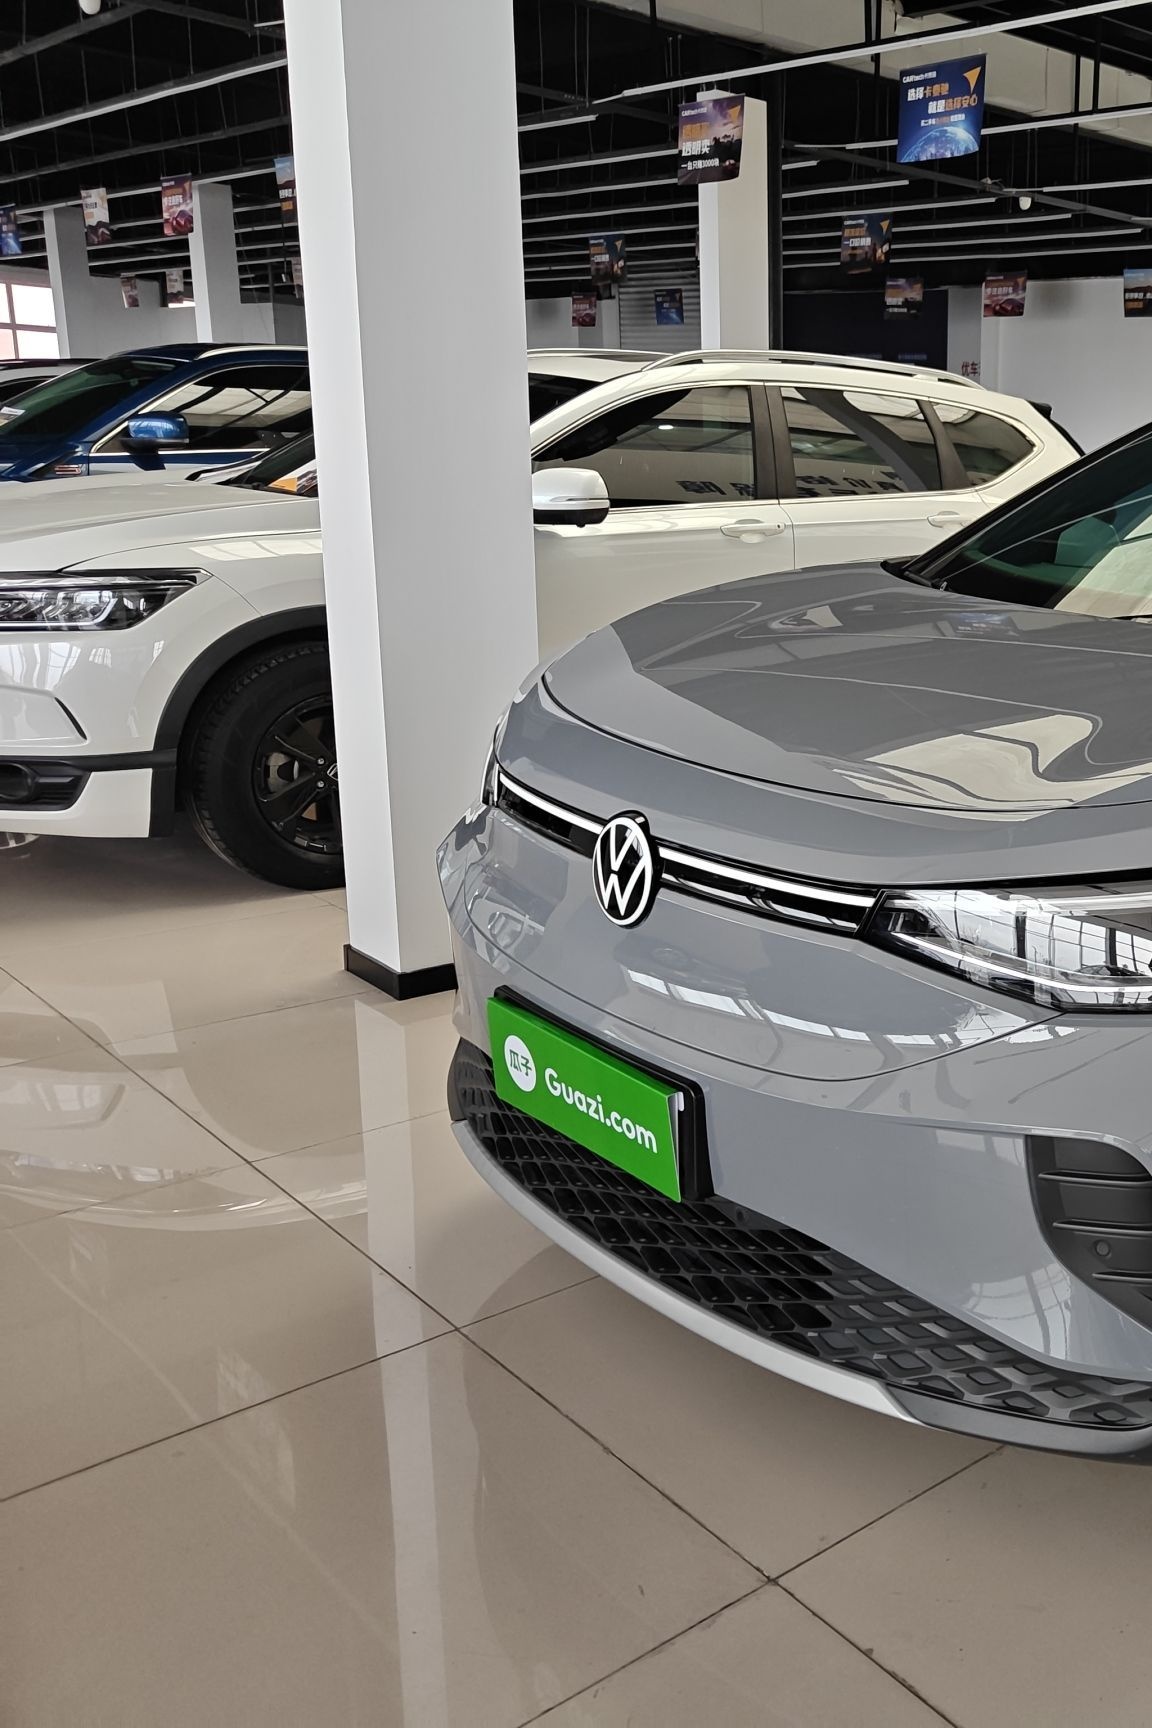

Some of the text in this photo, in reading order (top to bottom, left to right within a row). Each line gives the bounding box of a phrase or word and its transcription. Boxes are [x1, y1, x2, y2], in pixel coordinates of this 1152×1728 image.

[961, 361, 981, 377] 优车
[509, 1048, 533, 1077] 瓜子
[544, 1067, 658, 1154] Guazi.com
